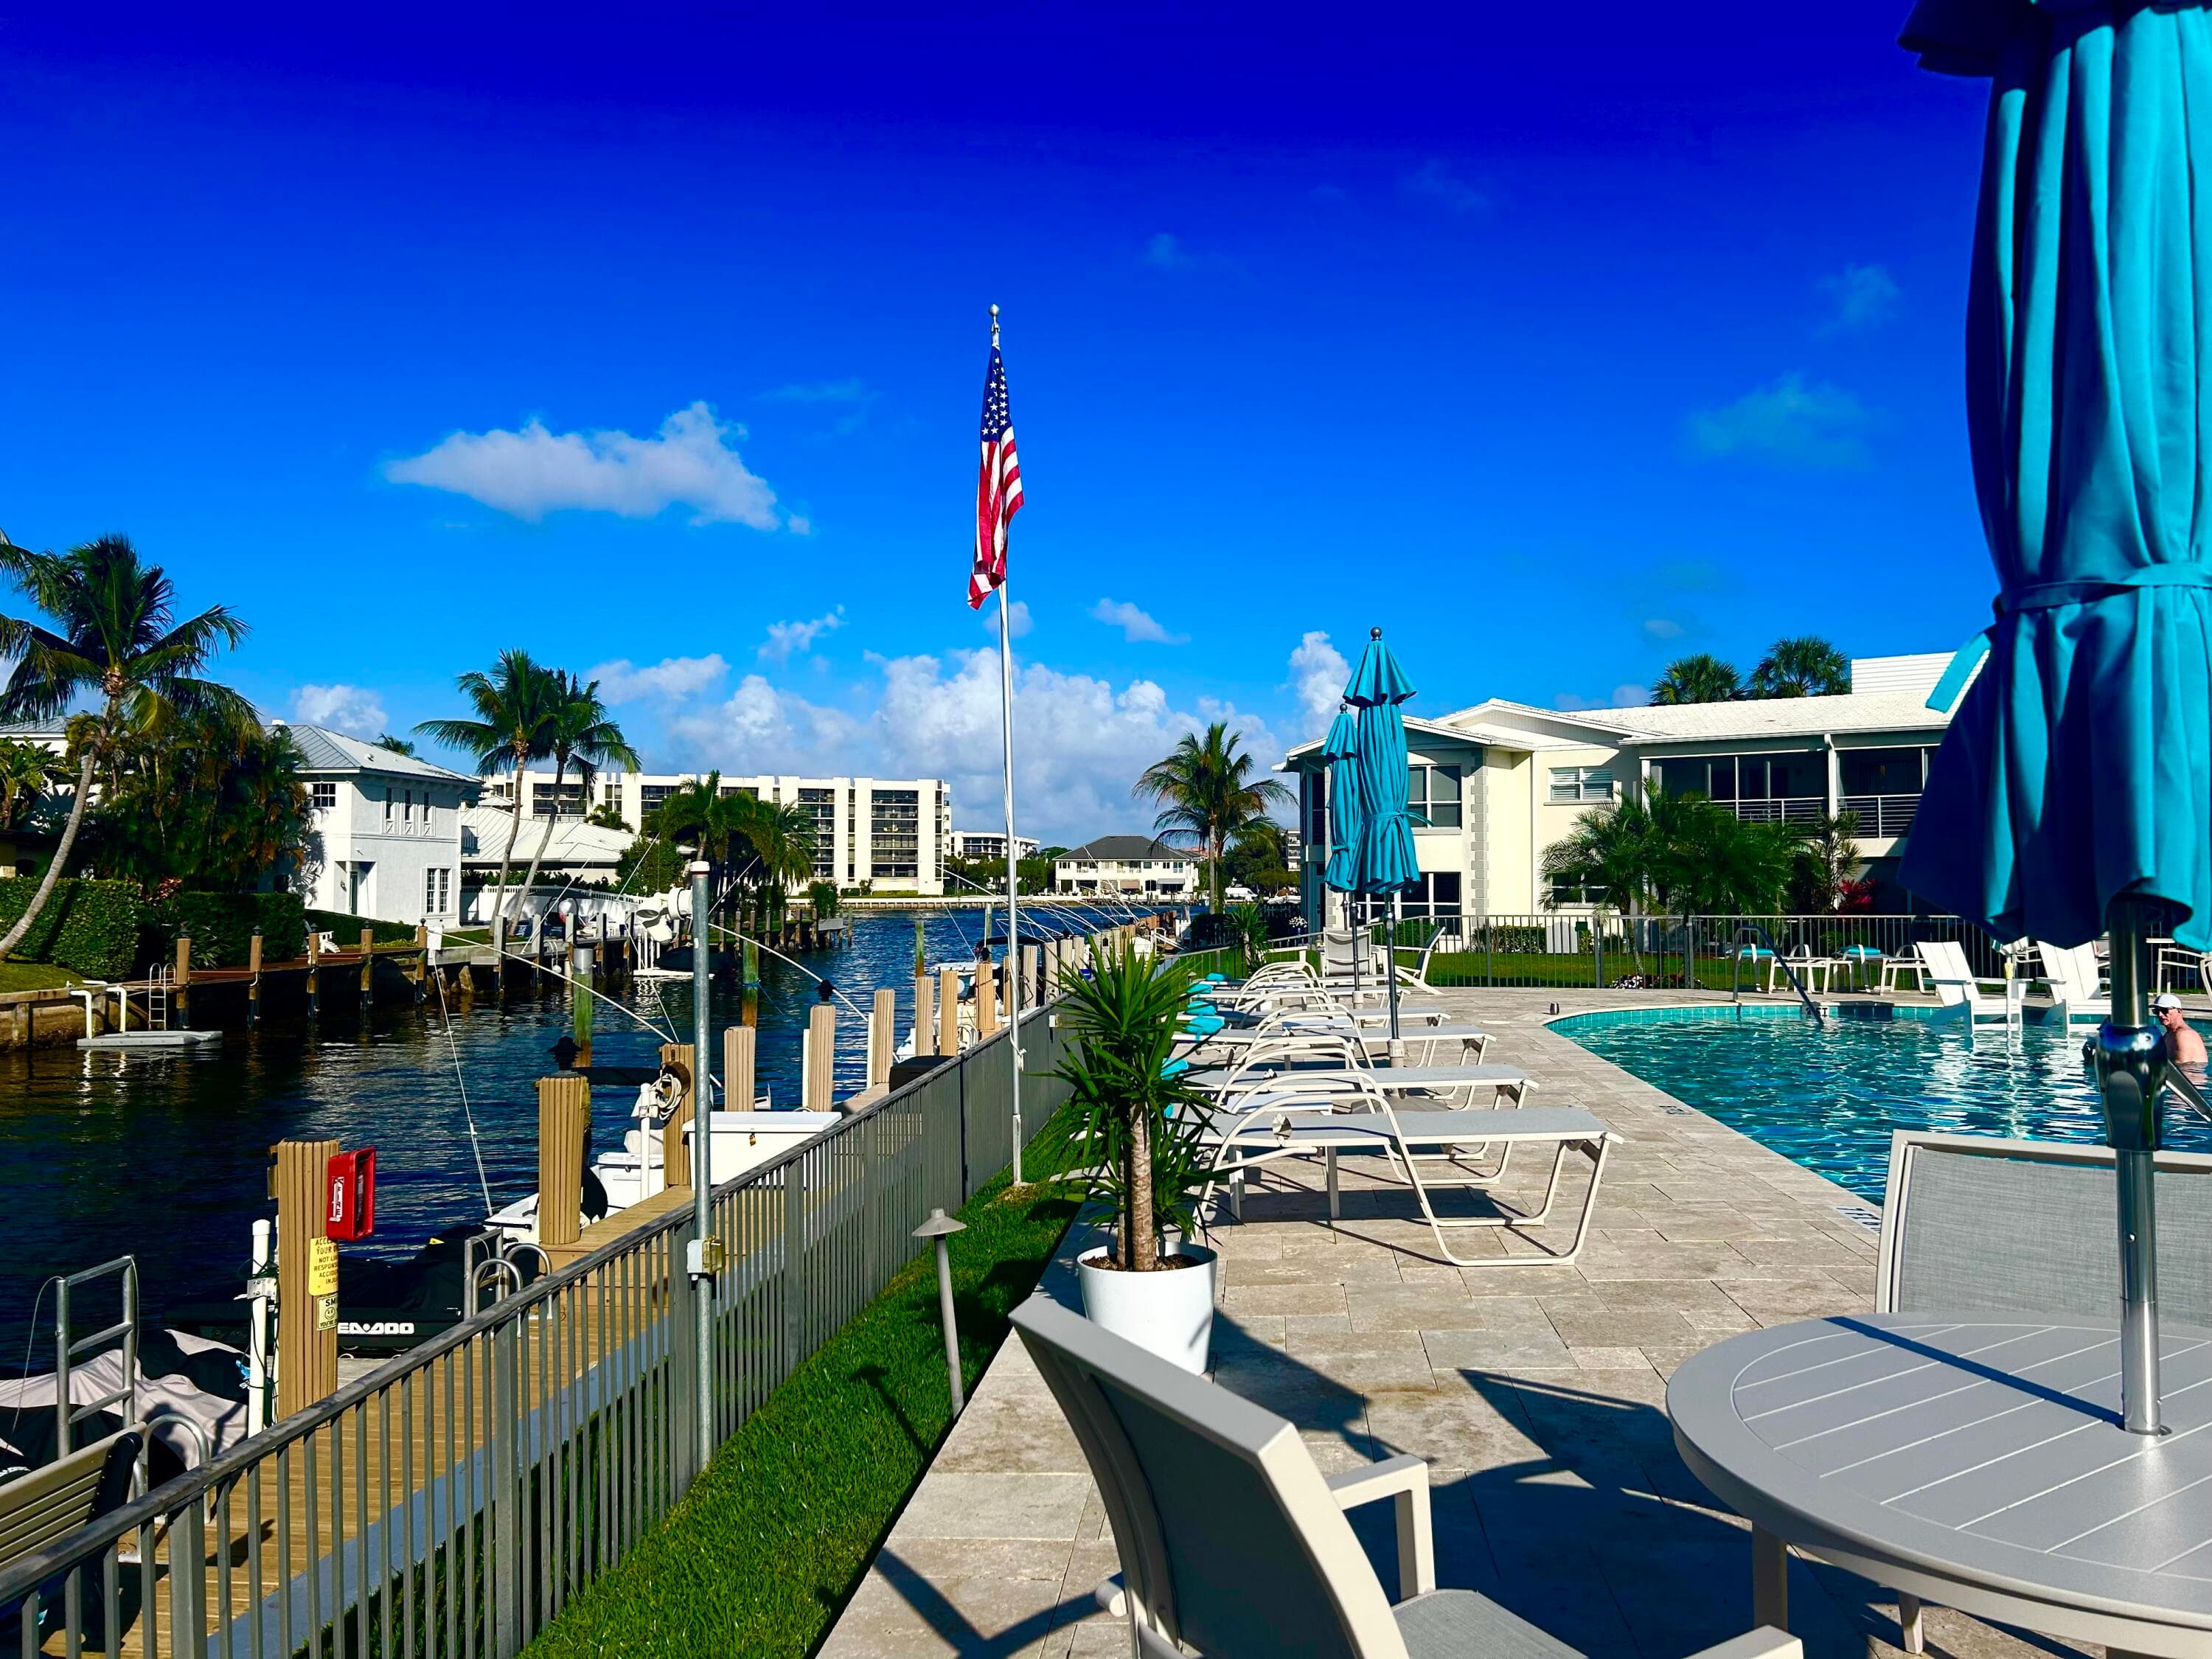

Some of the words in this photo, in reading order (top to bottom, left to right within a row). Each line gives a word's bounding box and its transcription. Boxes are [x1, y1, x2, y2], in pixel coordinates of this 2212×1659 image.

[316, 1246, 332, 1255] YOUR
[313, 1262, 338, 1271] RESPONS
[319, 1269, 338, 1278] ACCIDE
